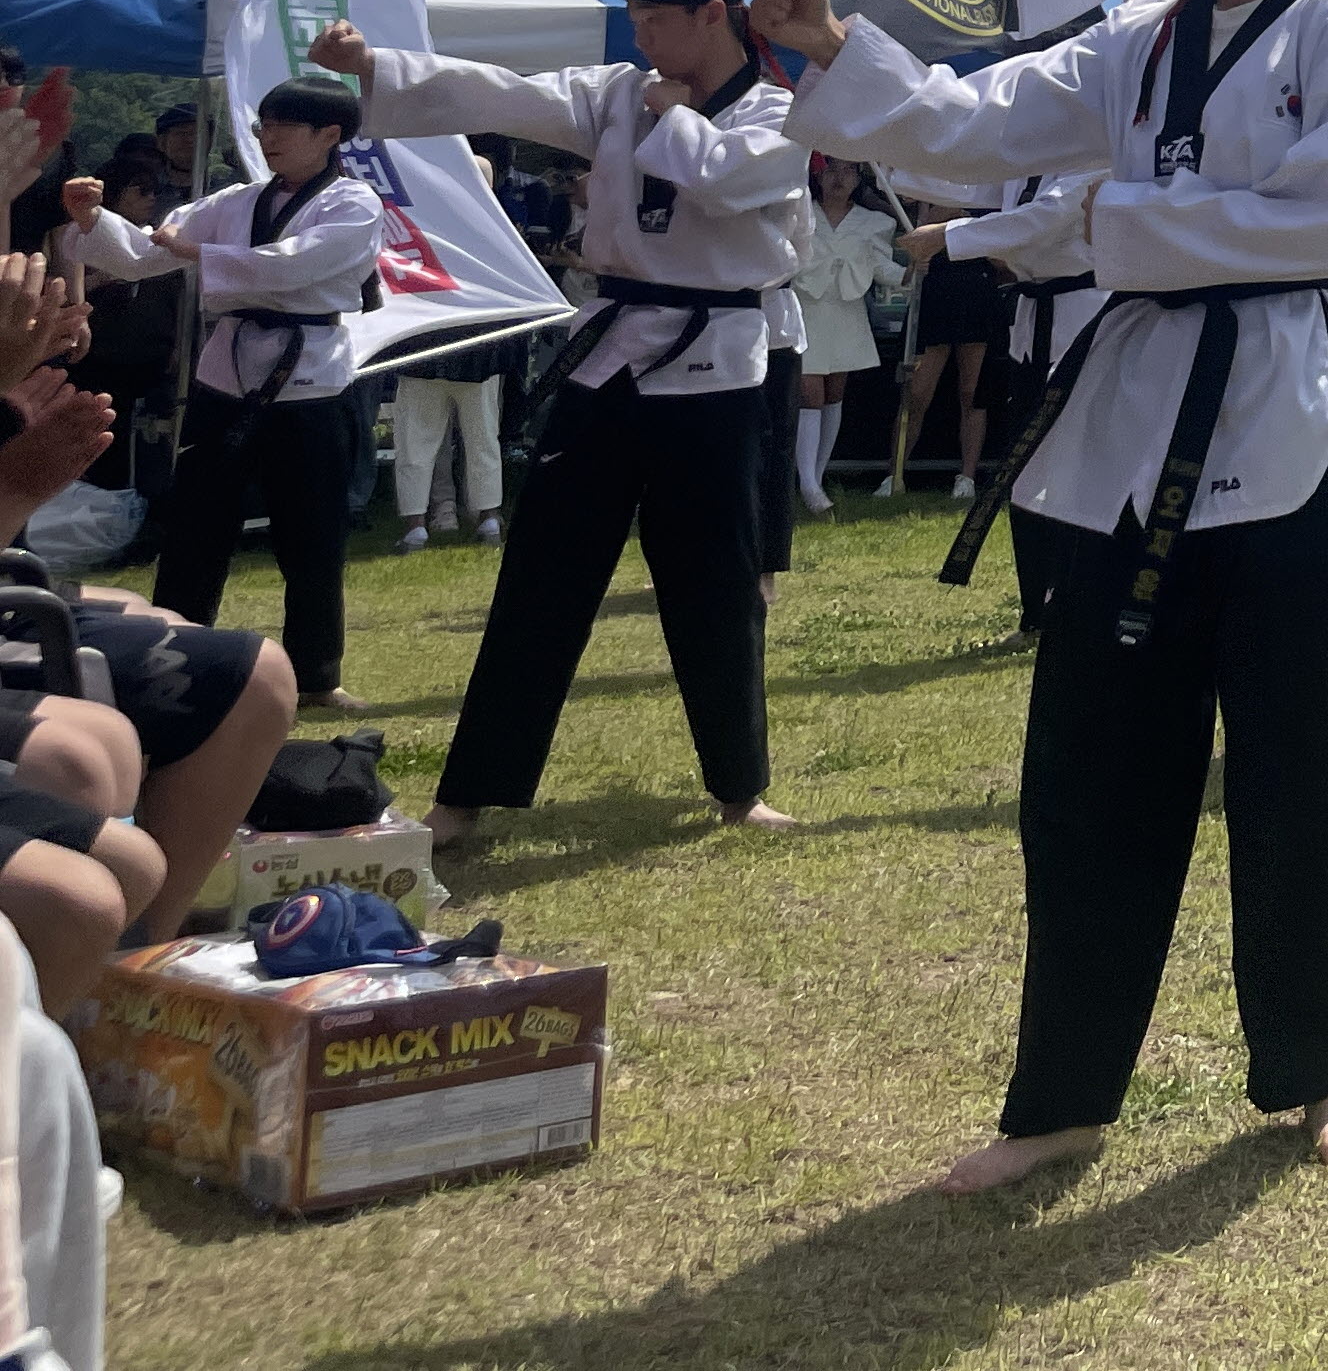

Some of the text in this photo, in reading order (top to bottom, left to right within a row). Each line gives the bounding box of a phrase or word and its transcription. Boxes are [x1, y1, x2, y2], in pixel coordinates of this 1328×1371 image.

[1211, 476, 1241, 495] FILA
[323, 1024, 440, 1076] SNACK
[451, 1012, 516, 1055] MIX
